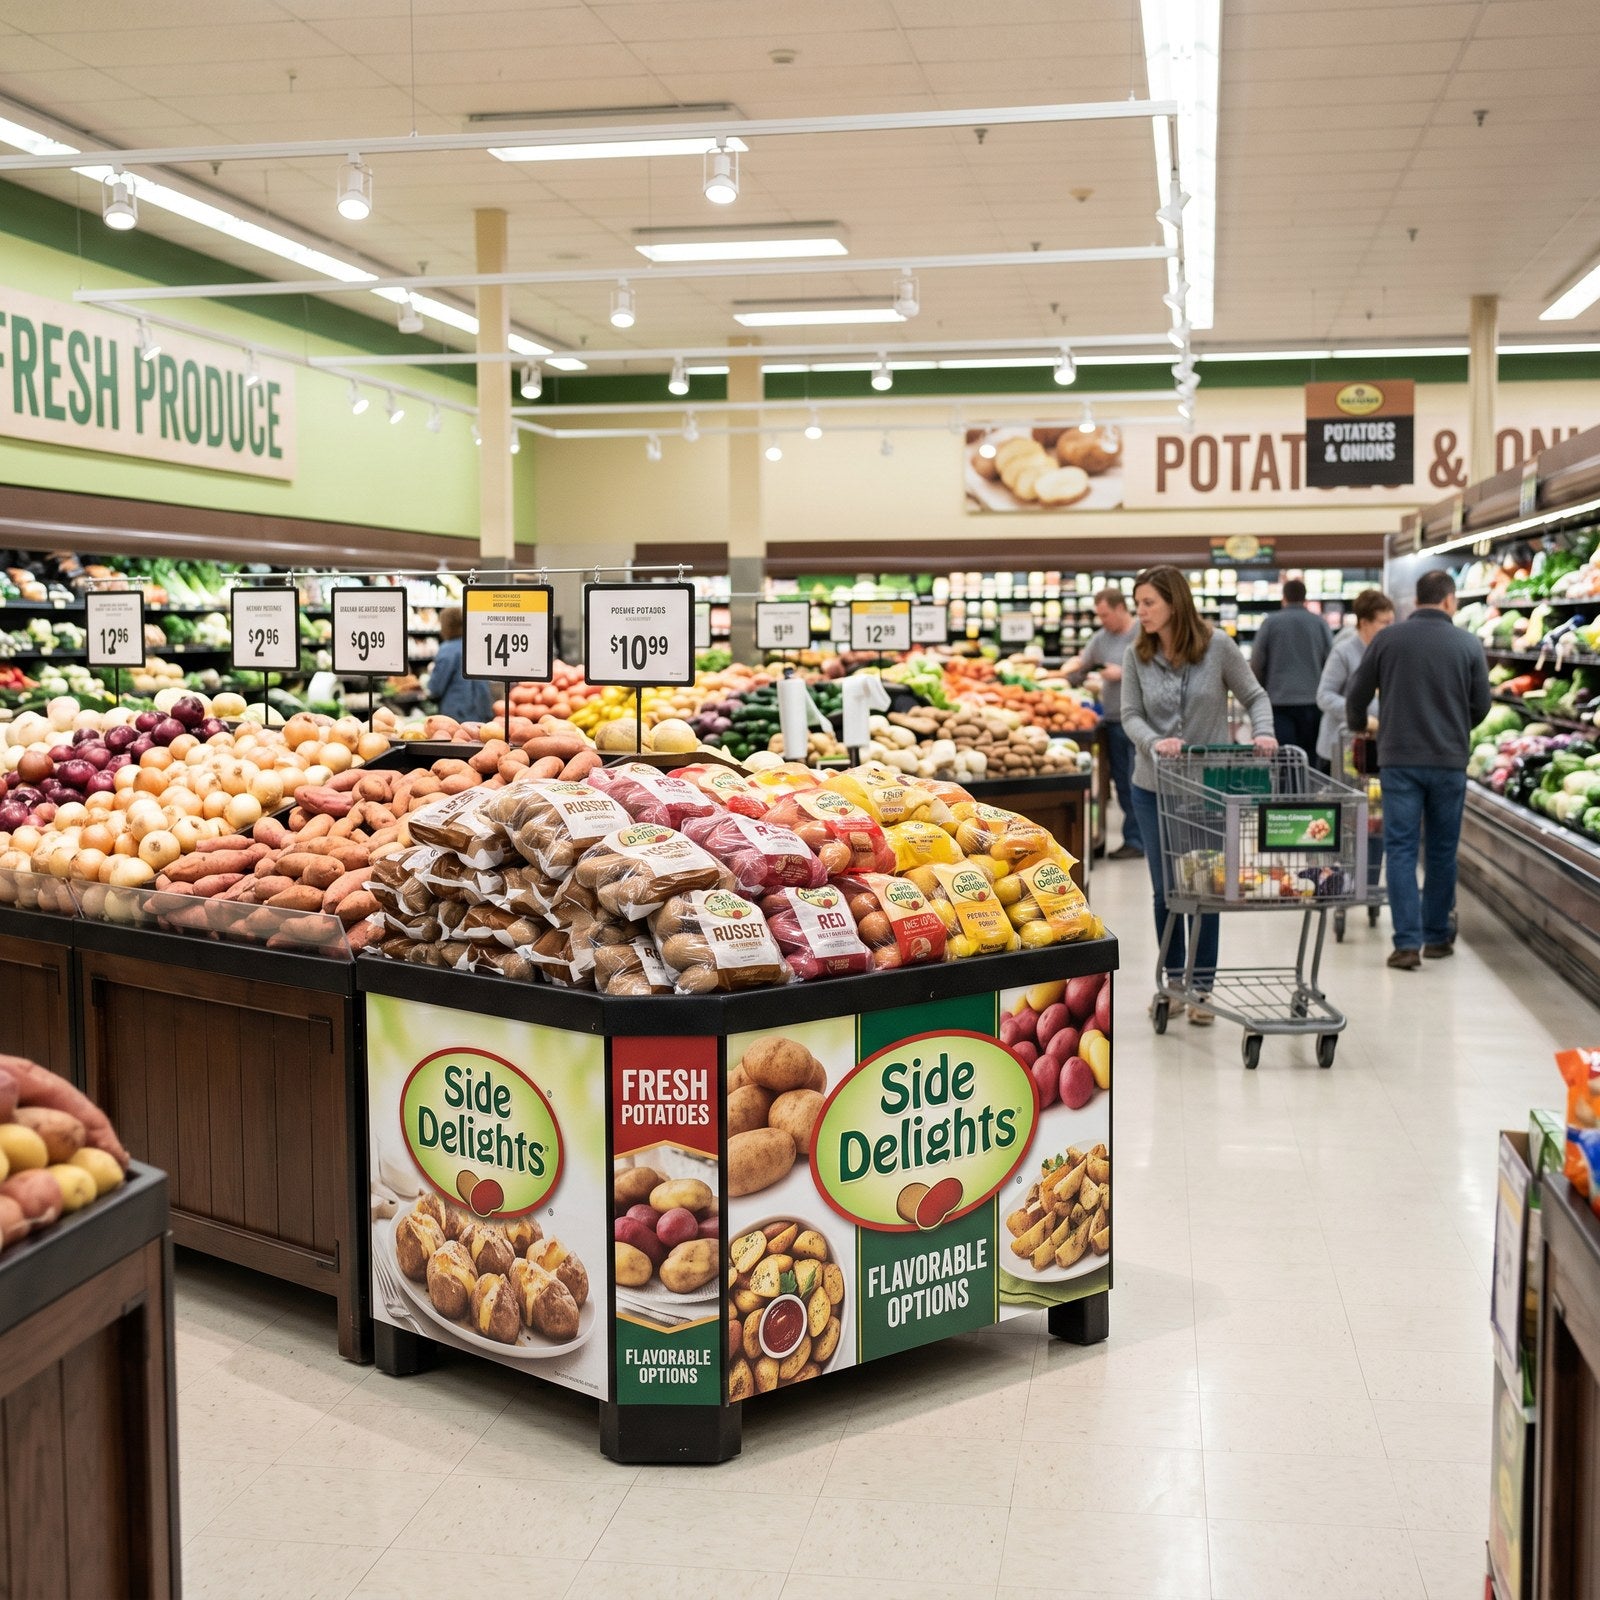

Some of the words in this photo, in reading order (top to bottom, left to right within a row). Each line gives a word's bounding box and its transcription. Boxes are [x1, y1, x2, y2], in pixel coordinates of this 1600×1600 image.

[0, 311, 120, 430] RESH
[134, 346, 283, 459] PRODUCE
[1323, 421, 1396, 442] POTATOES
[1324, 443, 1338, 463] &
[1340, 442, 1396, 462] ONIONS
[1429, 429, 1468, 488] &
[713, 923, 765, 941] RUSSET
[817, 912, 846, 930] RED
[444, 1065, 511, 1119] Side
[622, 1069, 708, 1101] FRESH
[881, 1053, 975, 1115] Side
[621, 1103, 710, 1125] POTATOES
[418, 1105, 546, 1177] Delights
[840, 1105, 1016, 1182] Delights
[868, 1238, 988, 1298] FLAVORABLE
[887, 1277, 970, 1328] OPTIONS
[625, 1349, 711, 1366] FLAVORABLE
[639, 1367, 698, 1384] OPTIONS
